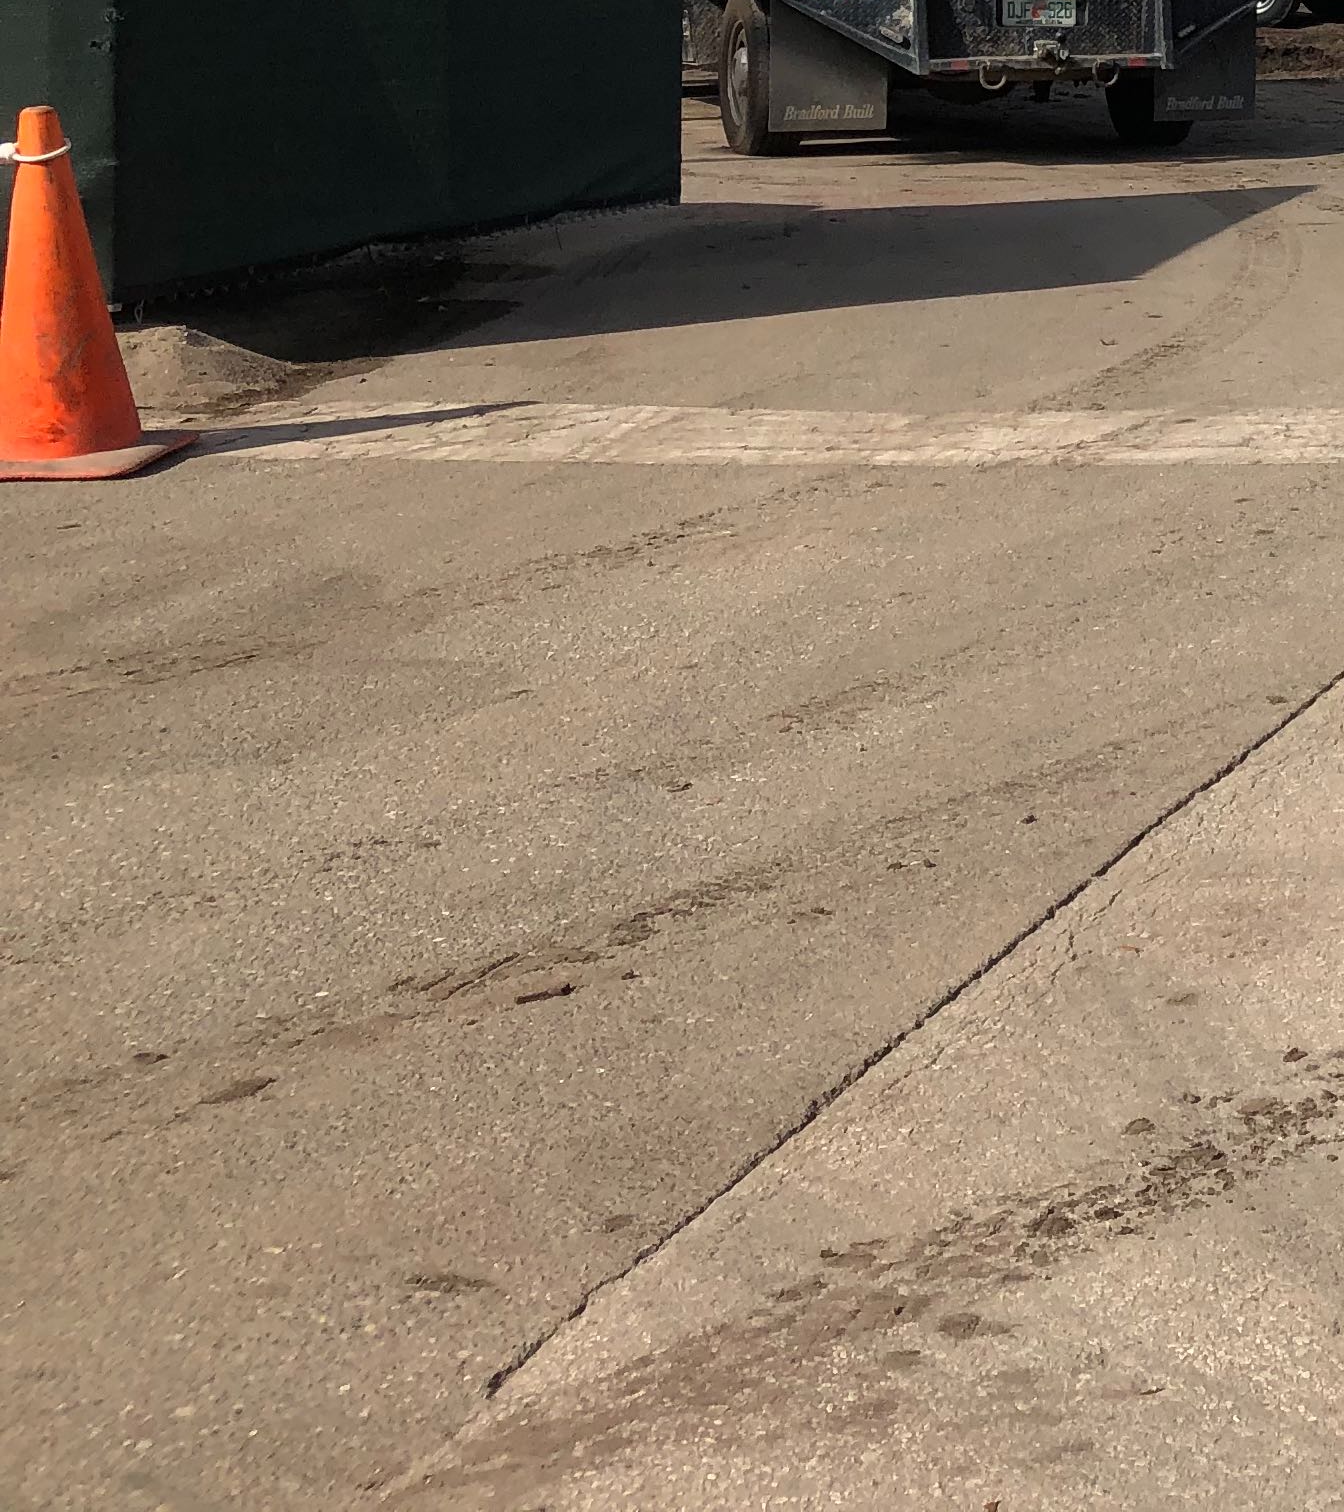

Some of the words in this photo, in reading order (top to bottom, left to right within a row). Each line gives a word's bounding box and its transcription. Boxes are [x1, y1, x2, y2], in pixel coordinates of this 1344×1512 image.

[1166, 95, 1215, 111] Bradford
[1217, 94, 1244, 110] Built
[784, 104, 840, 121] Bradford
[843, 103, 875, 119] Built
